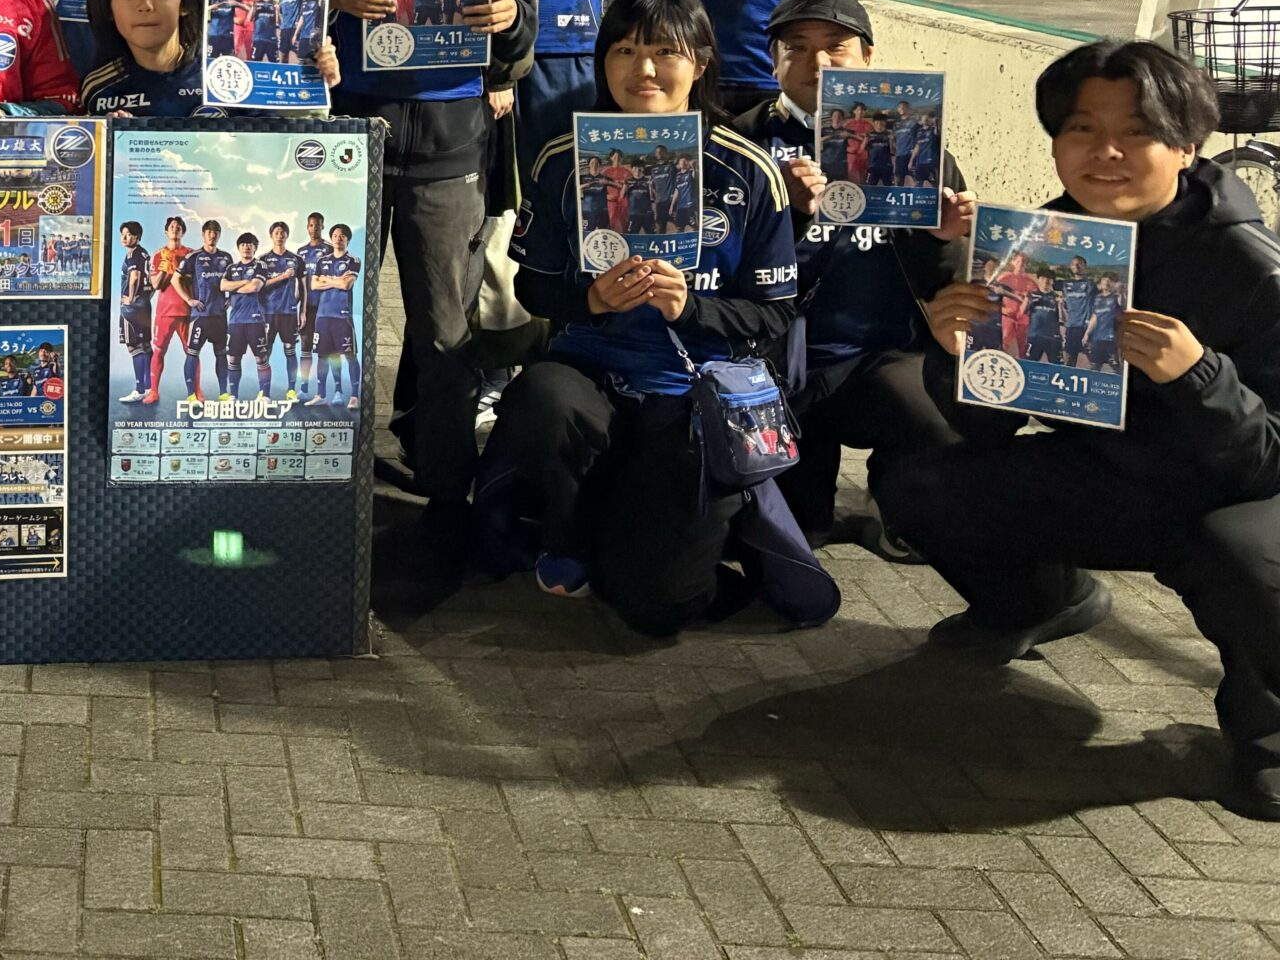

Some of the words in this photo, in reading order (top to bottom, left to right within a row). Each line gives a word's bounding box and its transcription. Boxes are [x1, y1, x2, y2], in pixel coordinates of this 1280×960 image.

[434, 31, 463, 45] 4.11
[272, 70, 299, 85] 4.11
[588, 127, 687, 142] まちだに集まろう!
[886, 192, 913, 206] 4.11
[648, 240, 676, 254] 4.11
[1051, 371, 1088, 395] 4.11
[176, 400, 293, 420] FC町田ゼルビア
